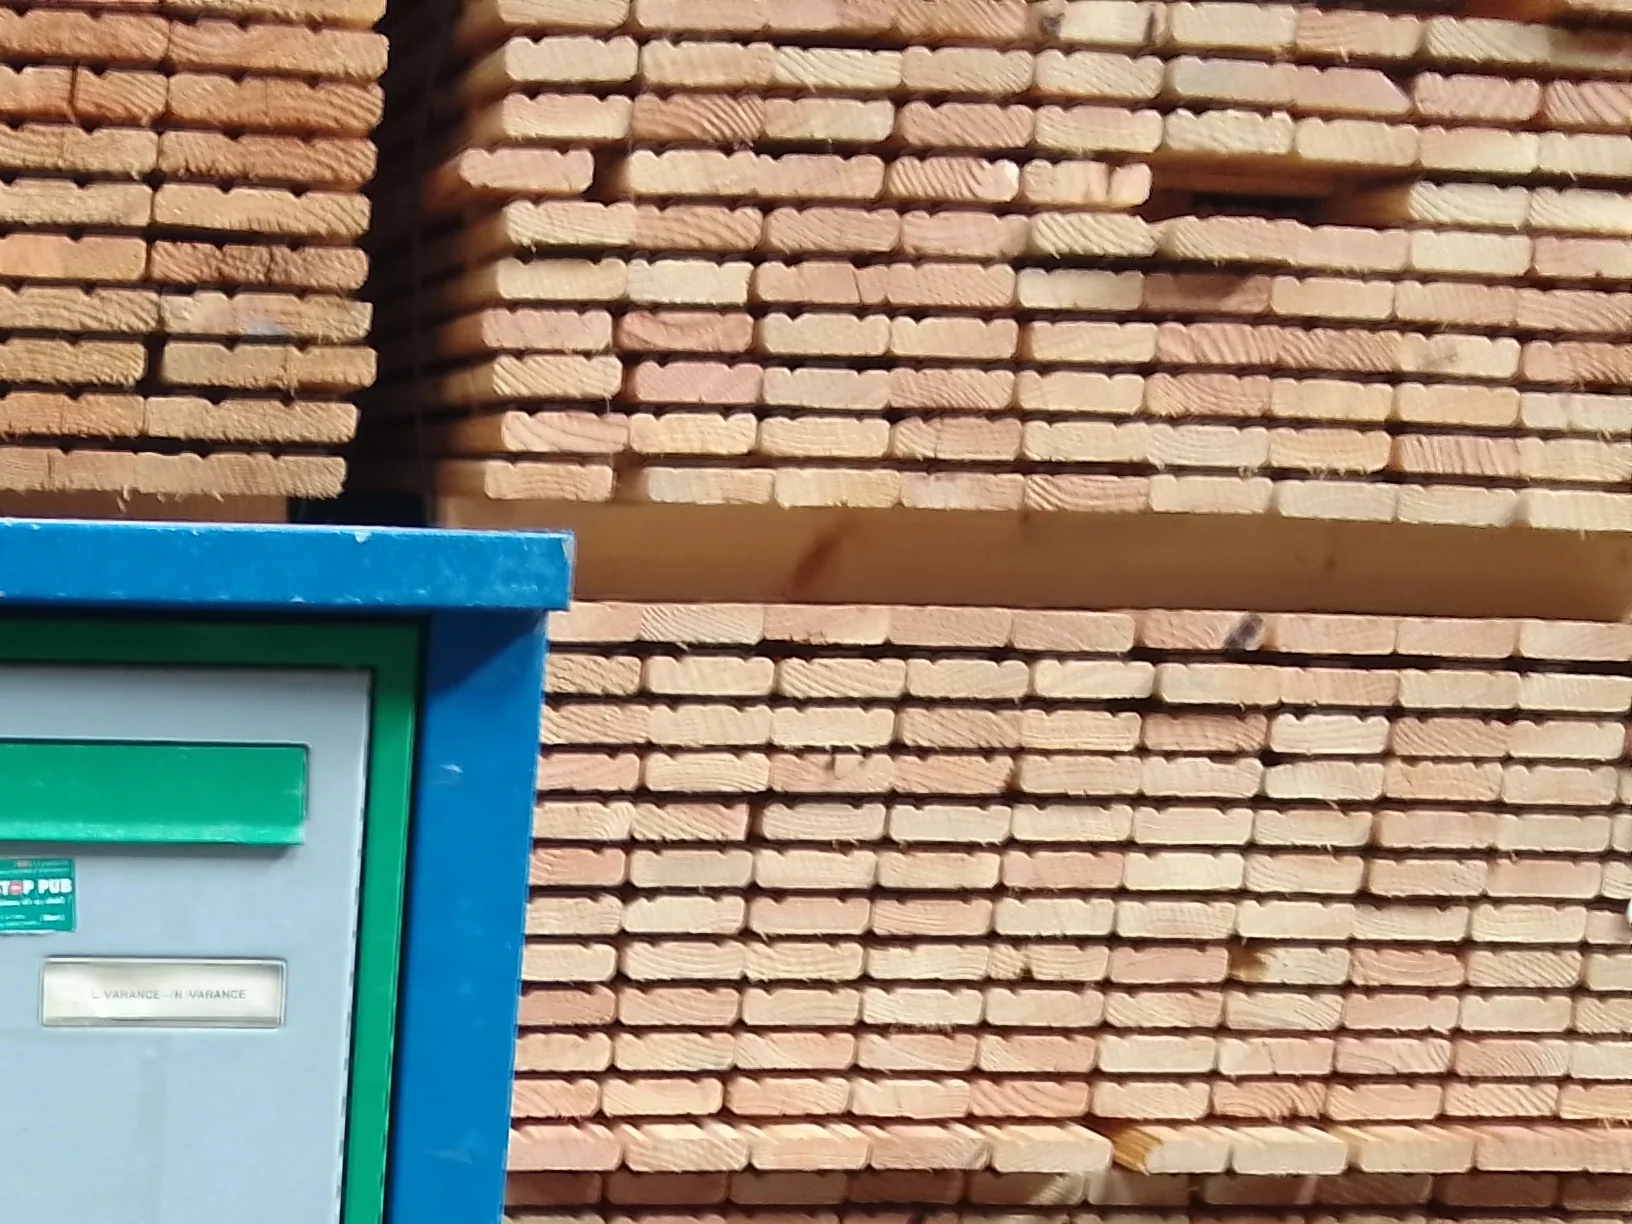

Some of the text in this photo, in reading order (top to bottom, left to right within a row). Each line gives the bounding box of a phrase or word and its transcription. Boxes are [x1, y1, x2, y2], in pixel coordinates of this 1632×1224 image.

[38, 878, 73, 894] PUB
[104, 989, 161, 1000] VARANCE
[188, 989, 247, 1000] VARANCE
